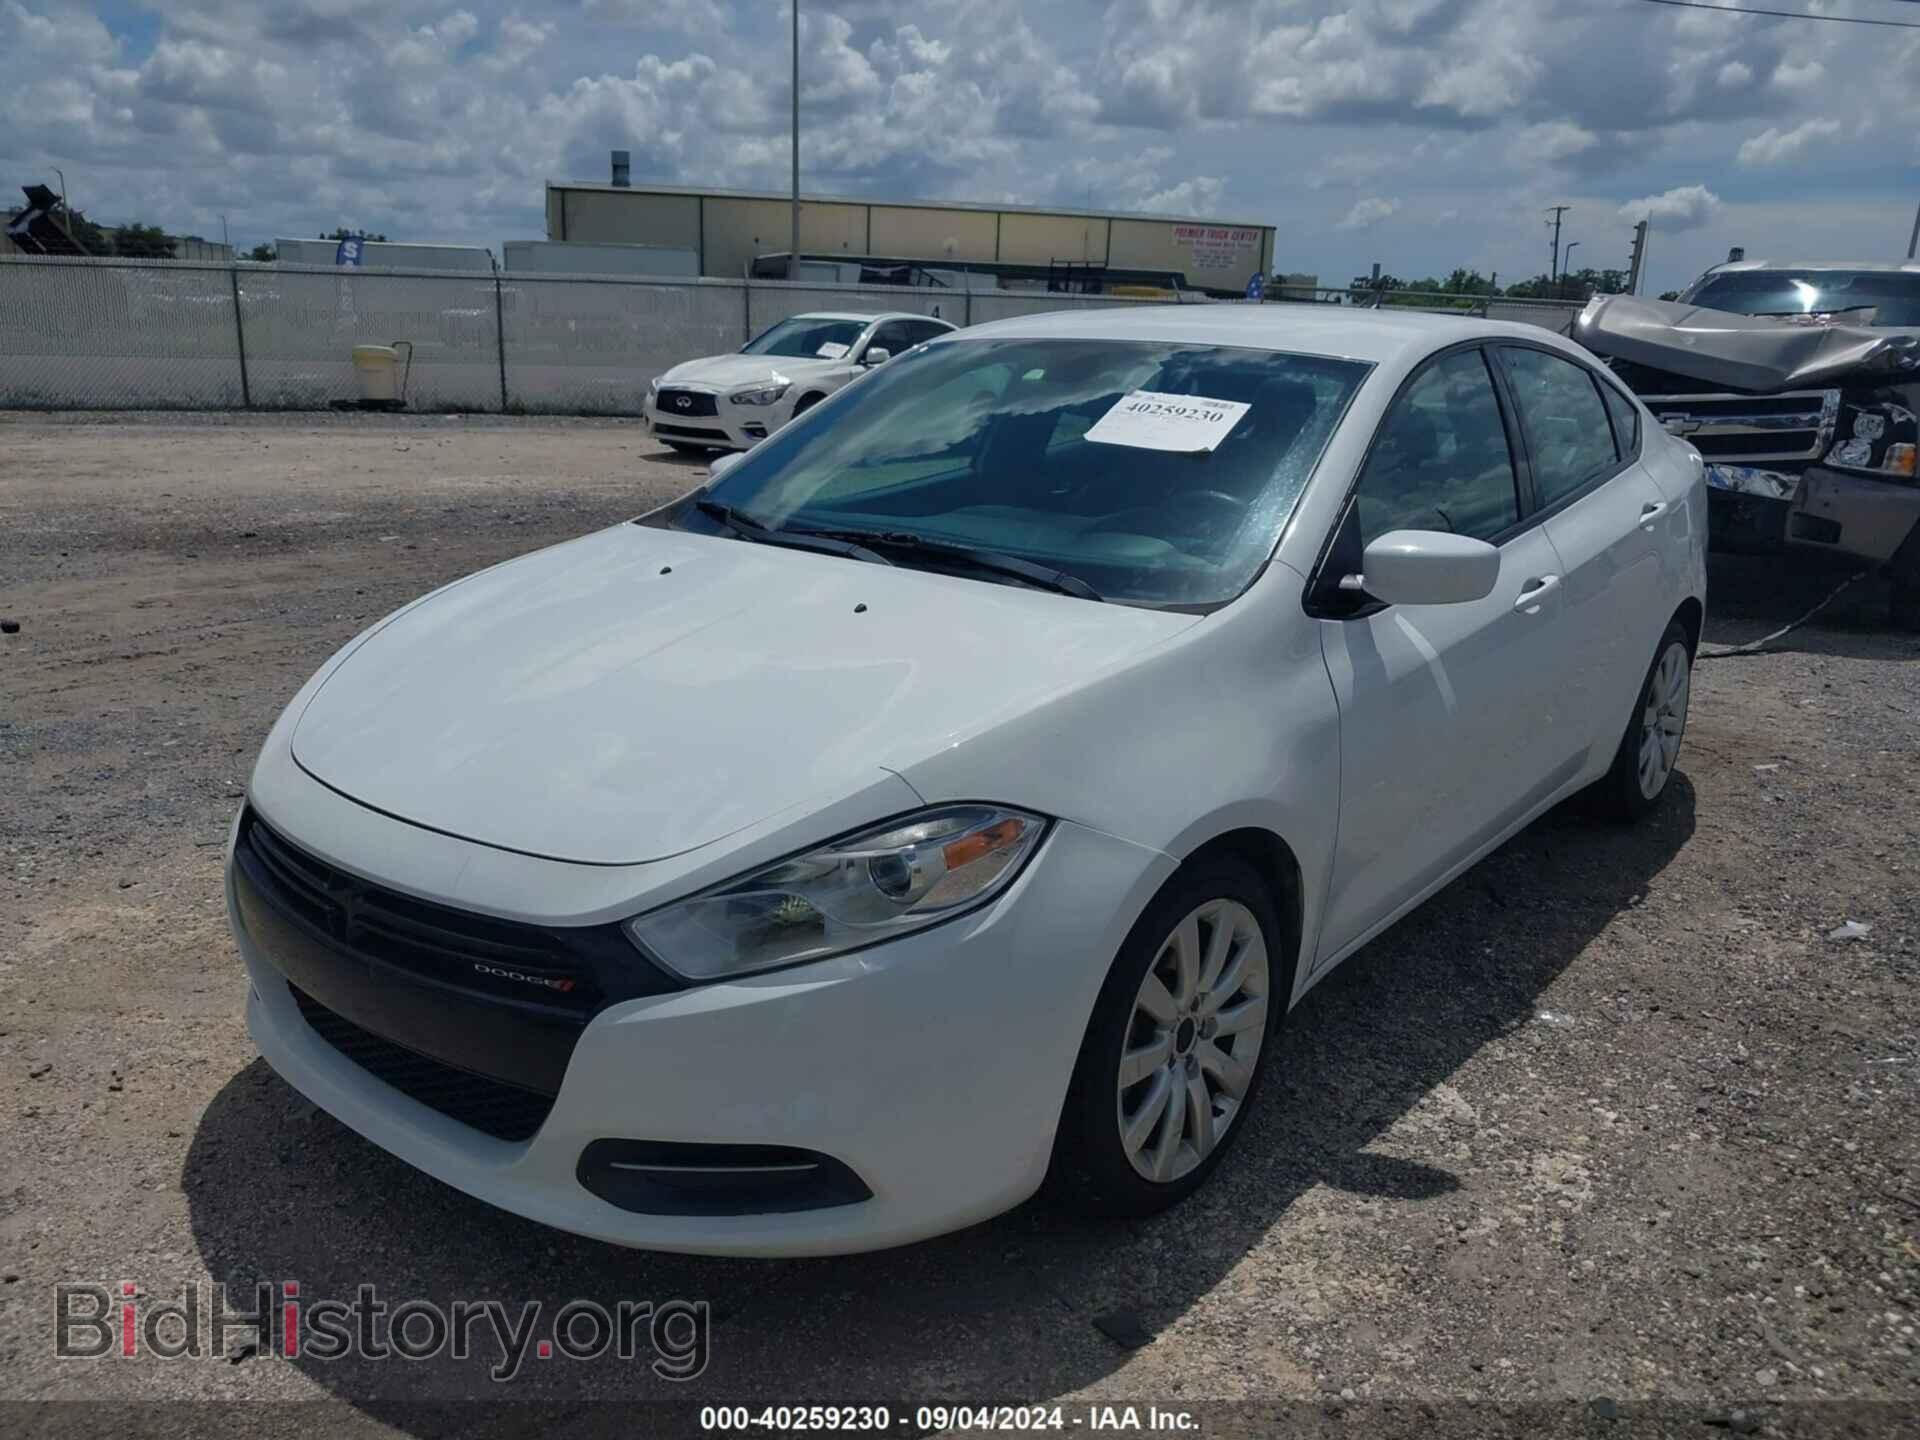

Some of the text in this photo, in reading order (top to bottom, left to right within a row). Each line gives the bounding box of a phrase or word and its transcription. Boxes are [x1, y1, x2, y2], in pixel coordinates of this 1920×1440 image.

[1174, 227, 1259, 241] PREMIER TRUCK CENTER
[1126, 402, 1224, 422] 40259230
[474, 963, 562, 989] DODGE
